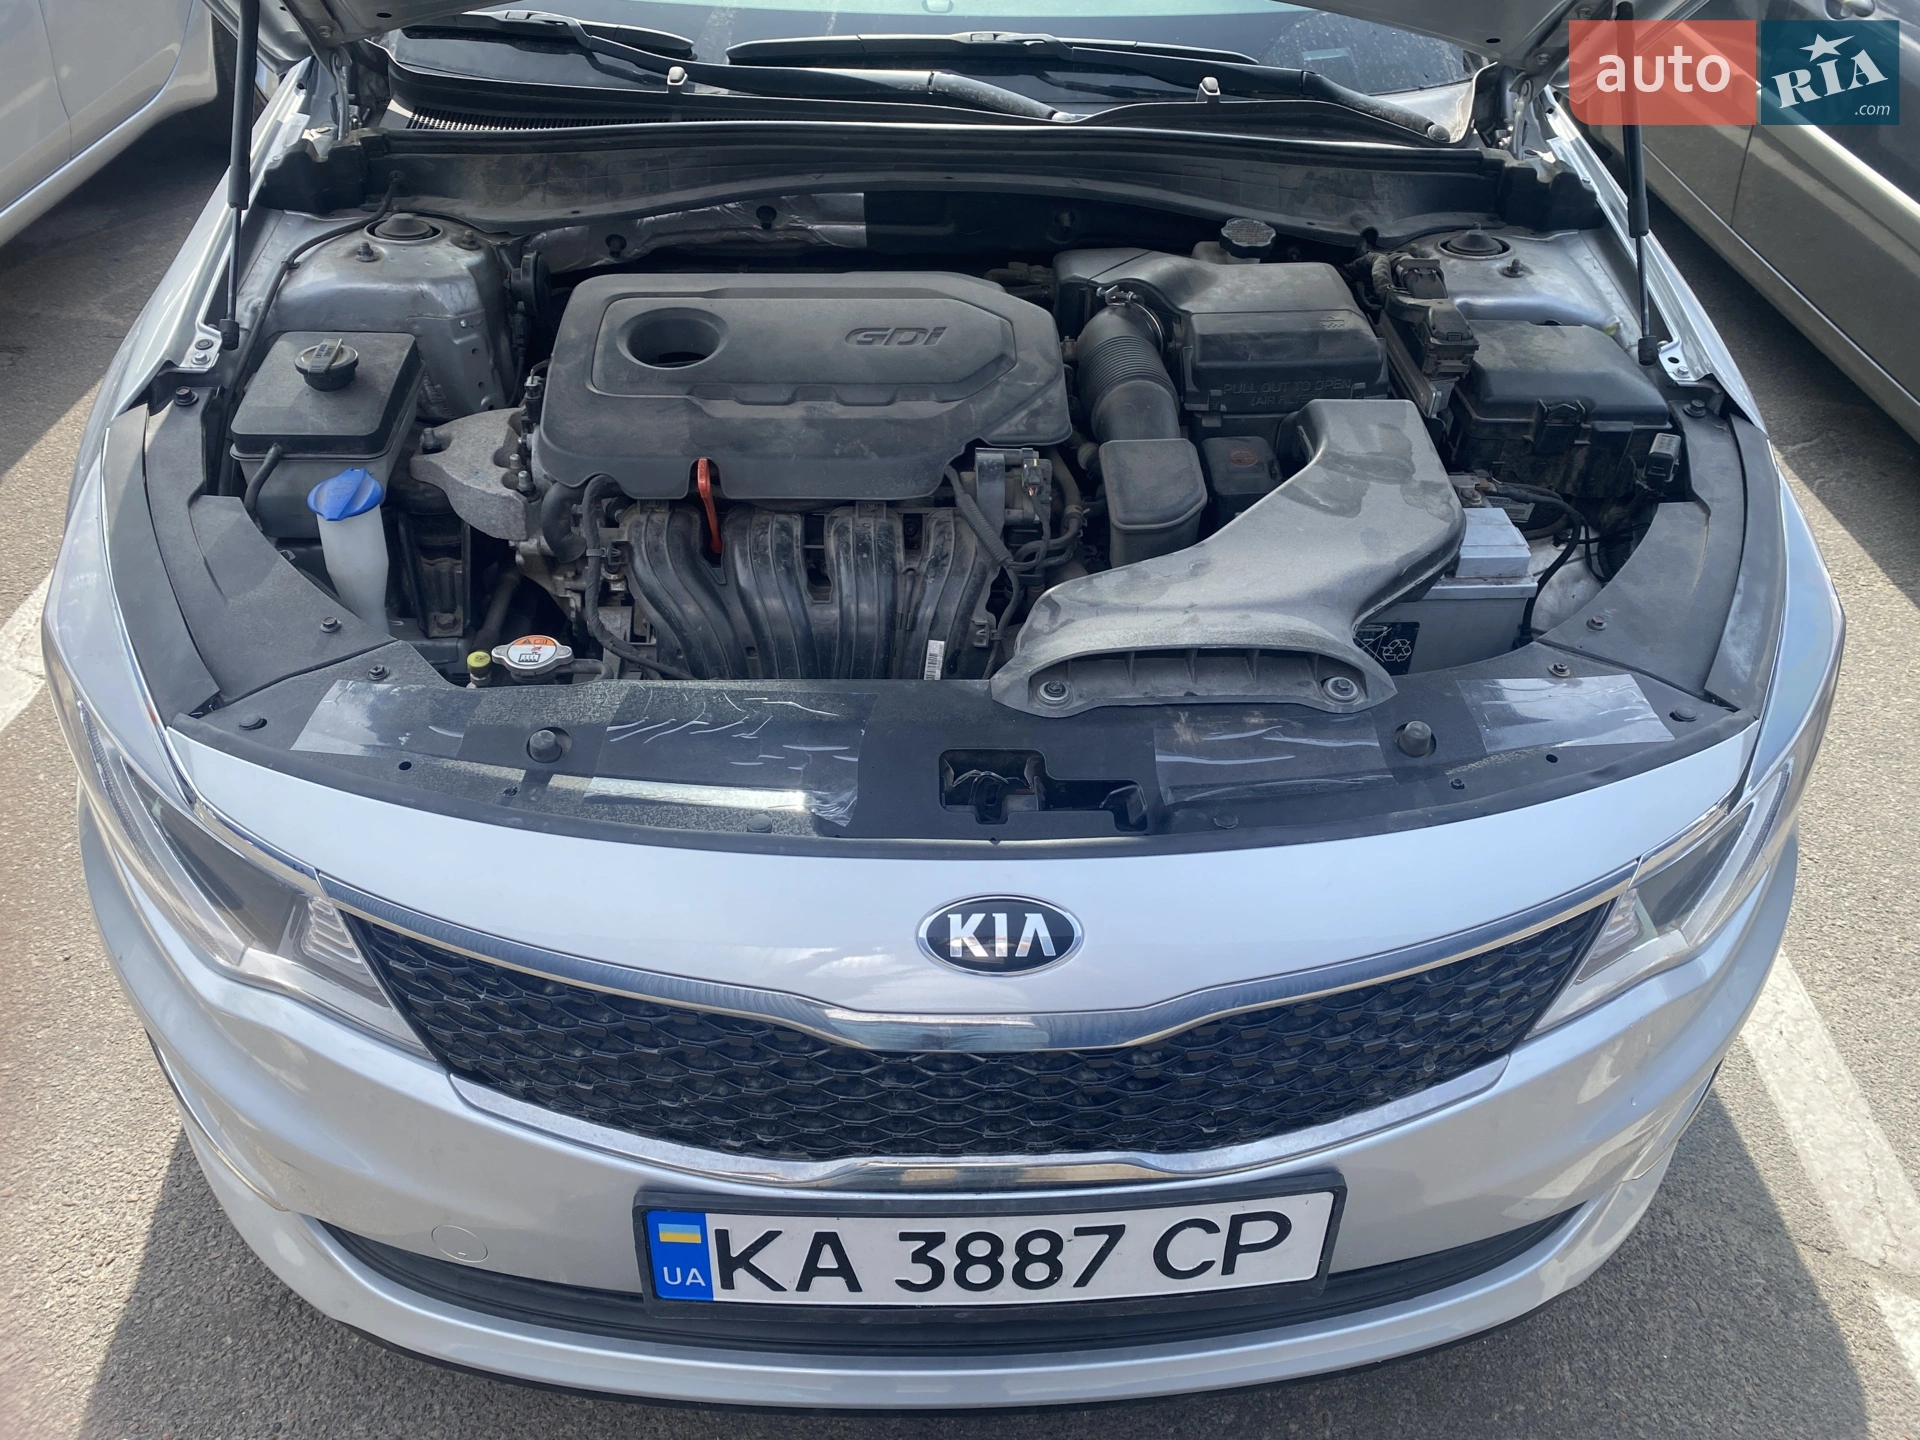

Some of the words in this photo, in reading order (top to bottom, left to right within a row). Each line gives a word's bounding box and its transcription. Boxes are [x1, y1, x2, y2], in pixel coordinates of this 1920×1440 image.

[1223, 383, 1258, 394] PULL
[1261, 381, 1291, 393] OUT
[1294, 381, 1311, 391] TO
[1314, 378, 1352, 391] OPEN
[947, 912, 1056, 958] KIA
[714, 1228, 863, 1293] KA
[895, 1224, 1126, 1293] 3887
[1153, 1210, 1292, 1280] CP
[663, 1266, 706, 1287] UA
